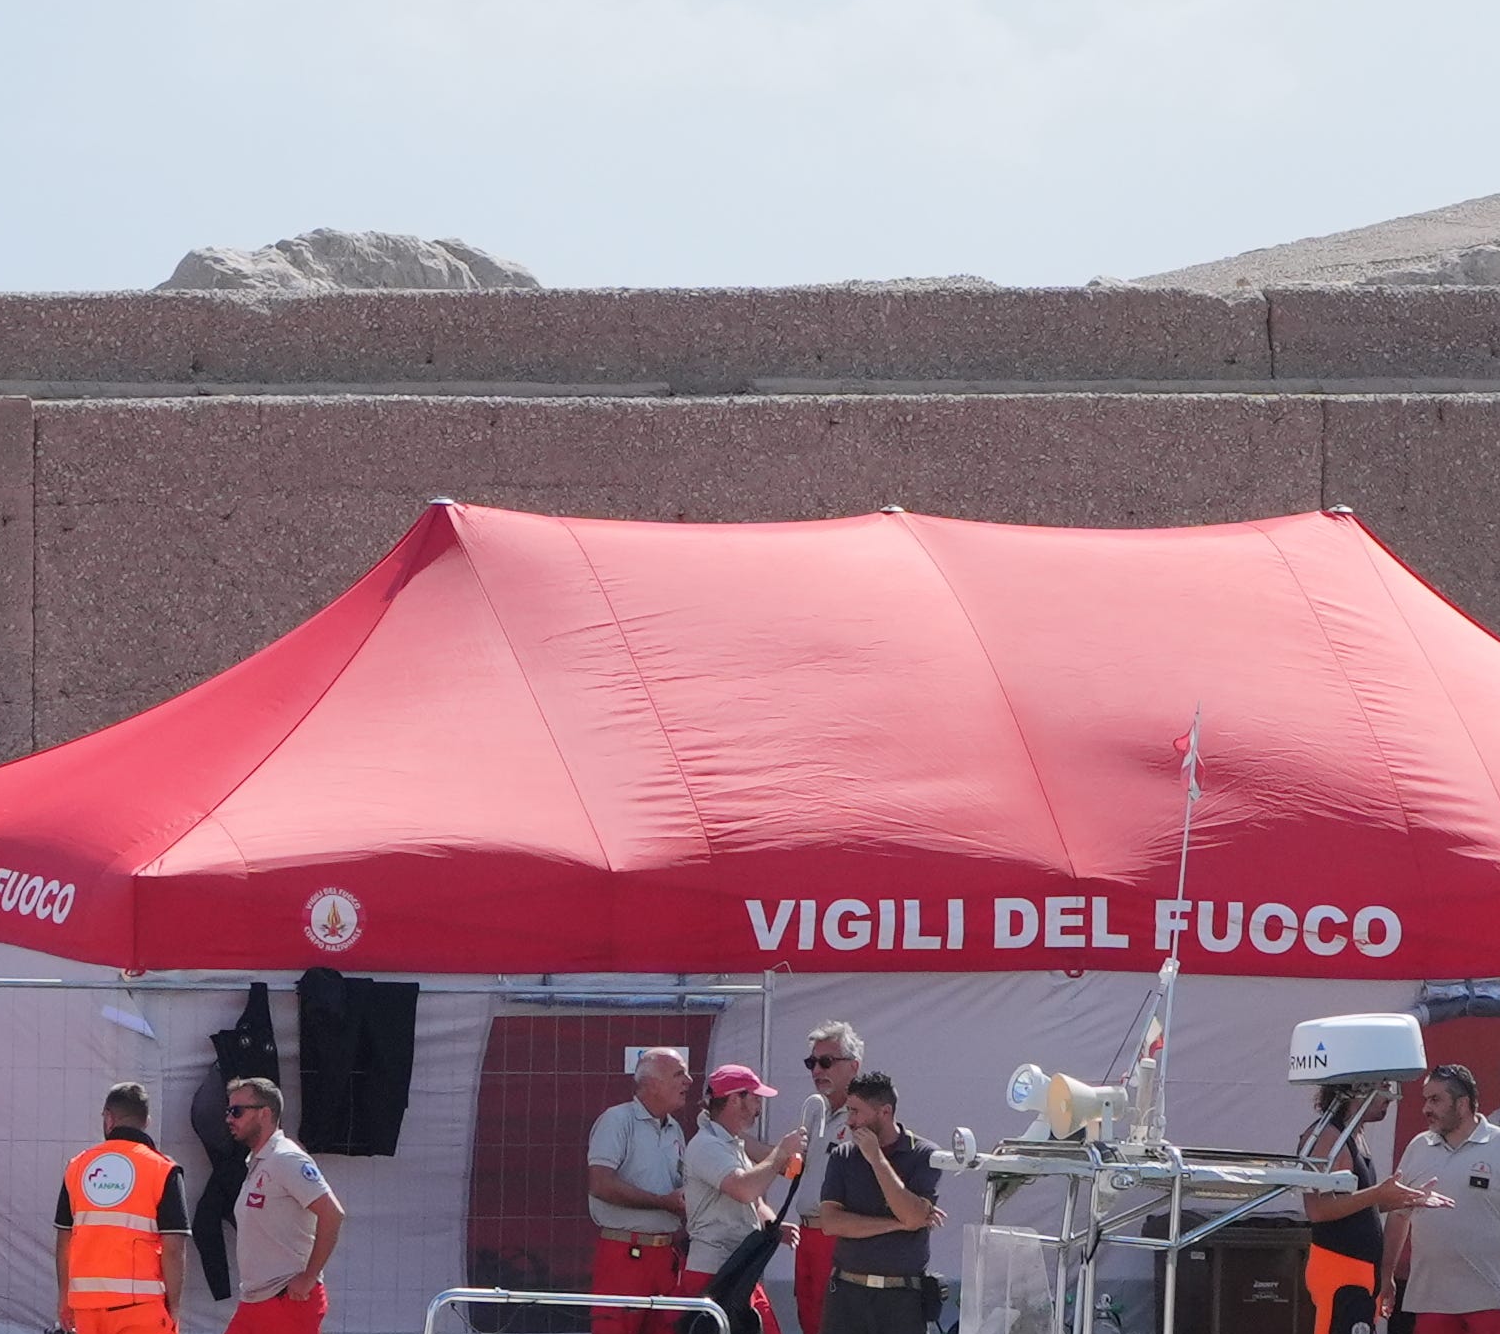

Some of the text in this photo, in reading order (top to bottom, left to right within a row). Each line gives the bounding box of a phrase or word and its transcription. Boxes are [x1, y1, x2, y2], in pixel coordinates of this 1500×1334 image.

[745, 896, 1402, 958] VIGILI DEL FUOCO
